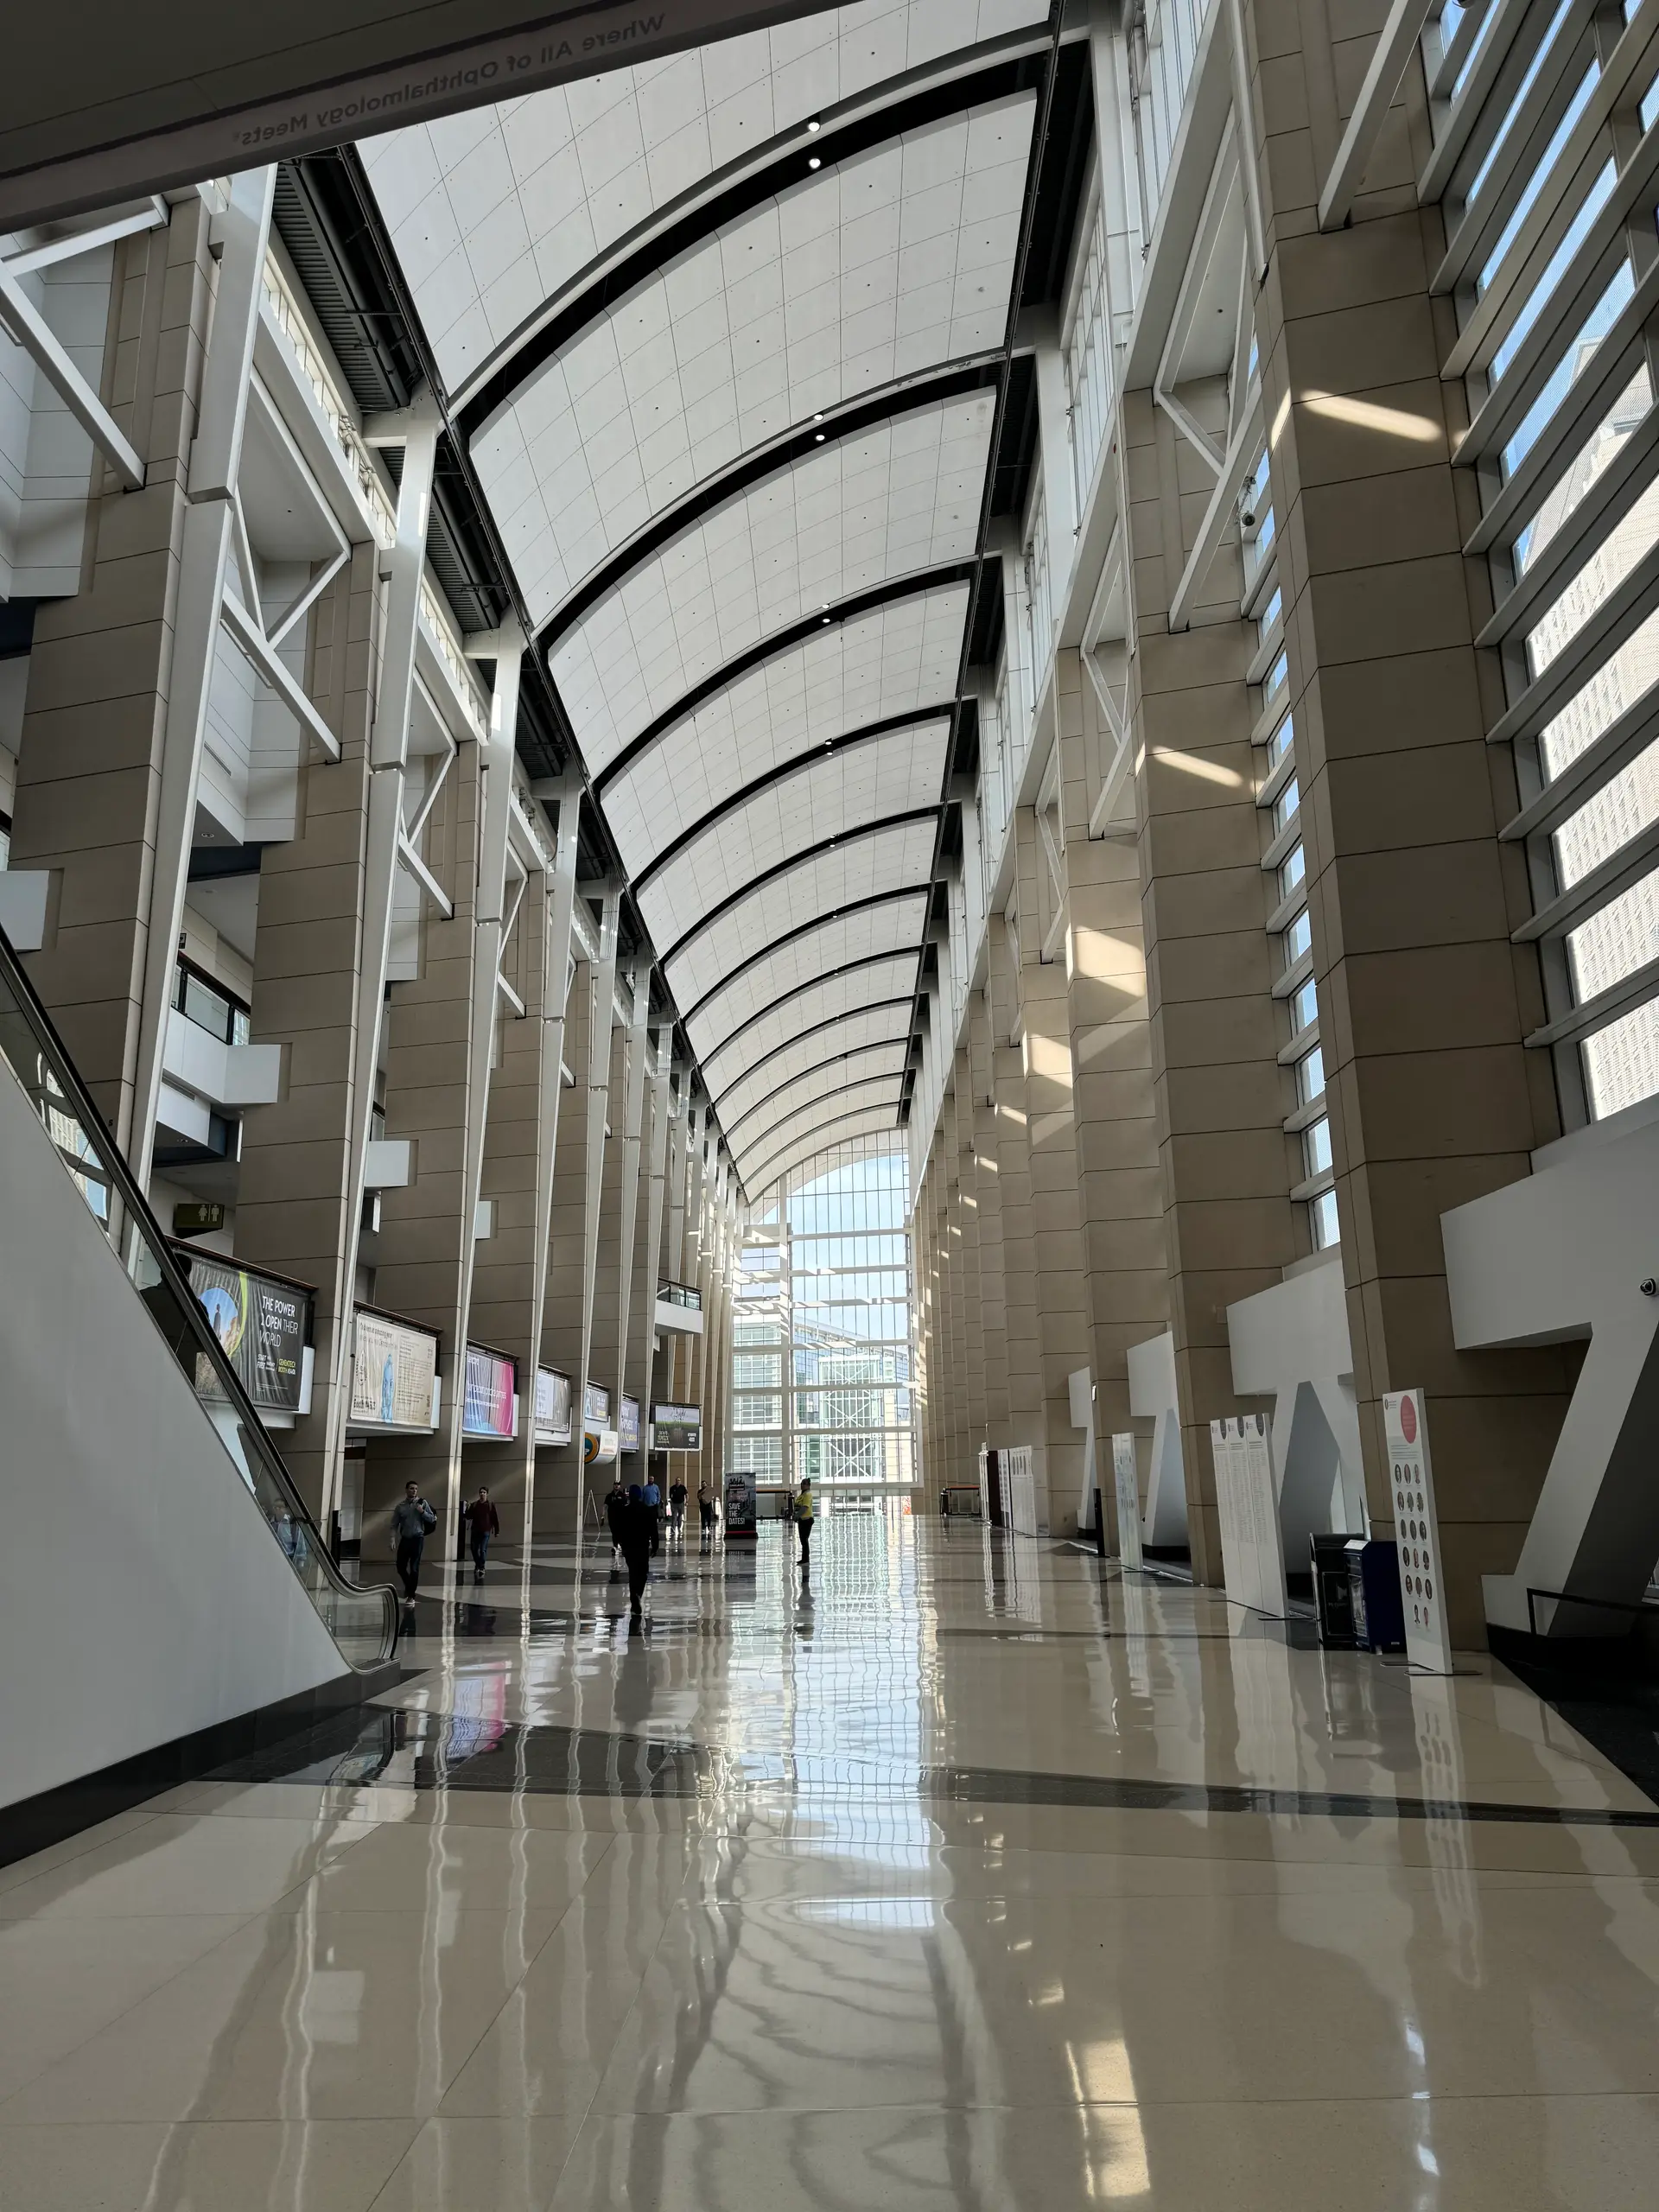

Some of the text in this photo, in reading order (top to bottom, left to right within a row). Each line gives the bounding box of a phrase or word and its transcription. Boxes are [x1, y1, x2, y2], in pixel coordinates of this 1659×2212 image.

[262, 1295, 296, 1318] THE POWER
[265, 1314, 282, 1330] OPEN
[259, 1330, 282, 1347] WORLD
